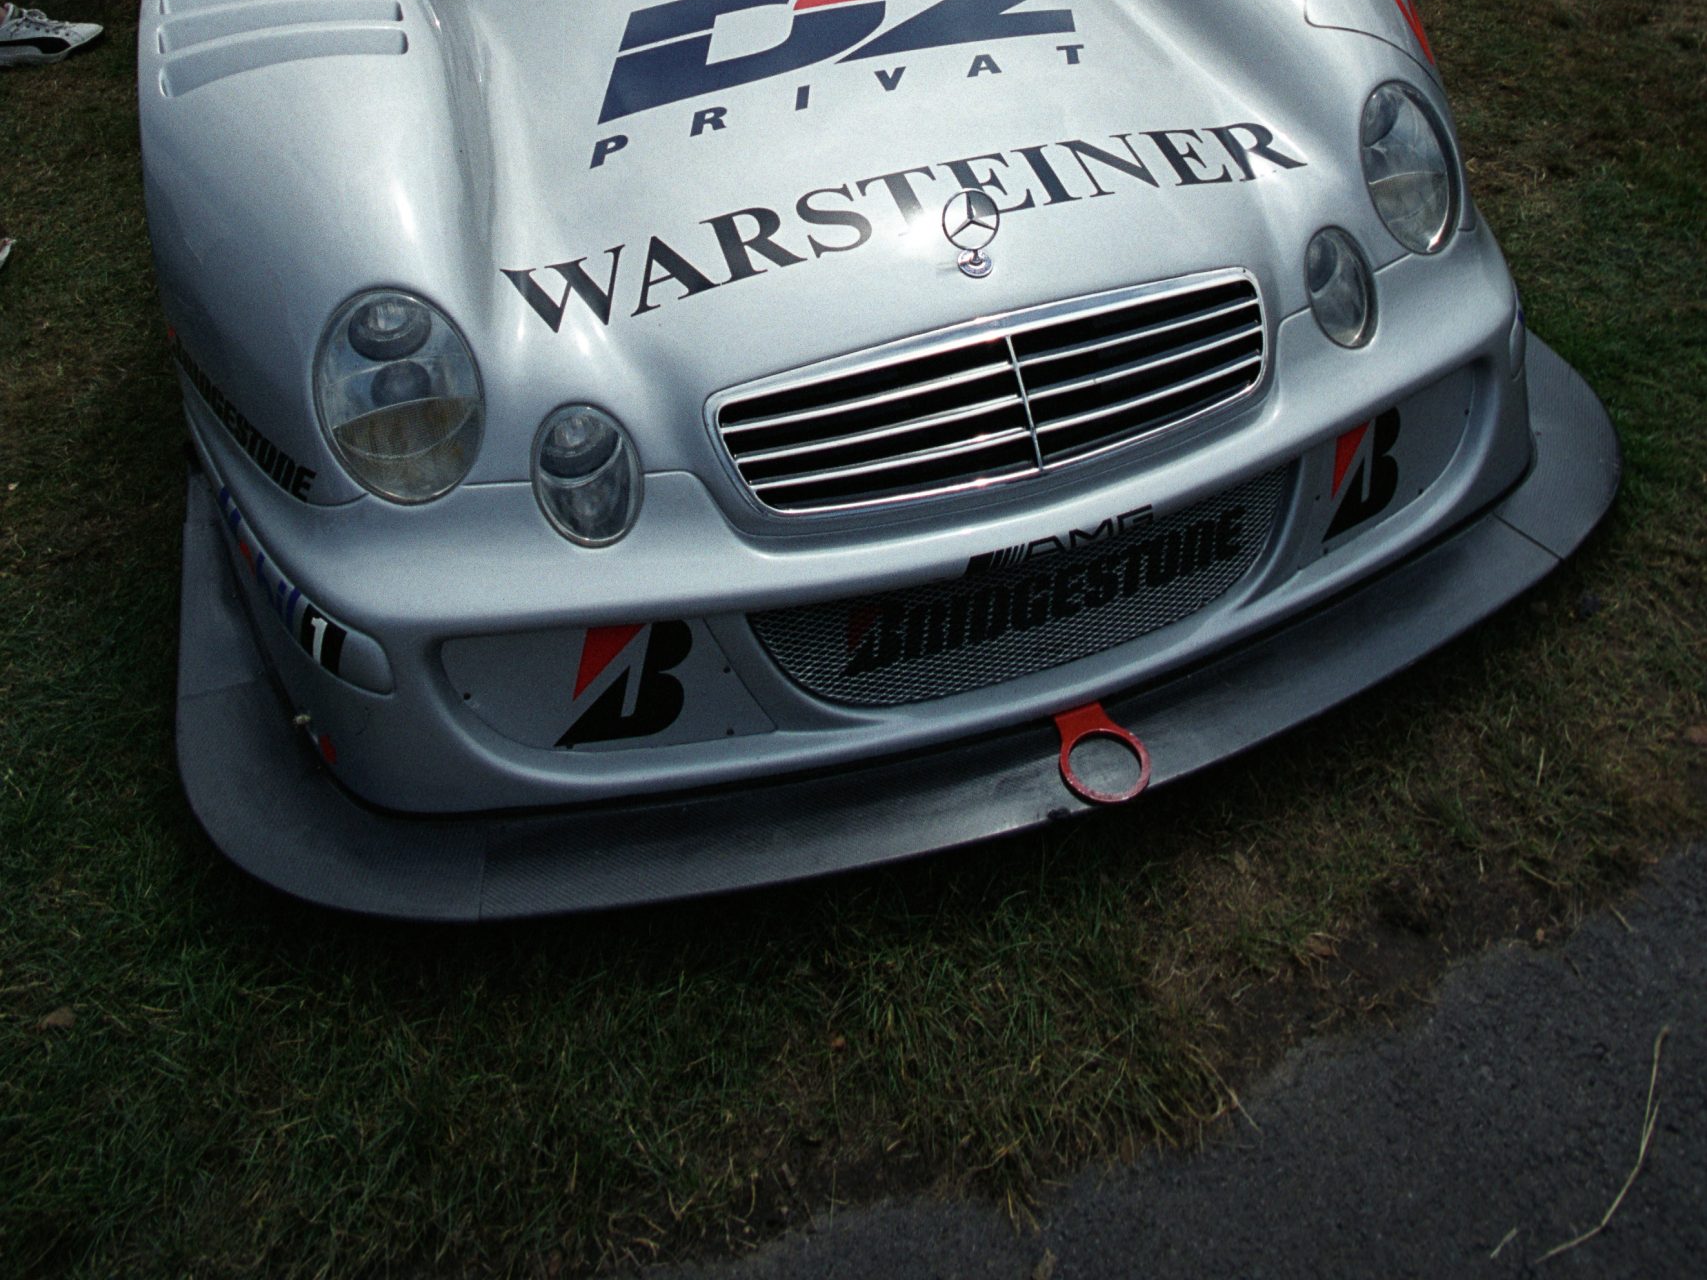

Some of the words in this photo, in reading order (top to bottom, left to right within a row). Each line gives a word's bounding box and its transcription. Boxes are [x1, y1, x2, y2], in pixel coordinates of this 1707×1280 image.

[590, 43, 1085, 169] PRIVAT
[500, 122, 1309, 334] WARSTEINER
[311, 616, 328, 665] 1
[842, 506, 1246, 677] BRIDGESTONE
